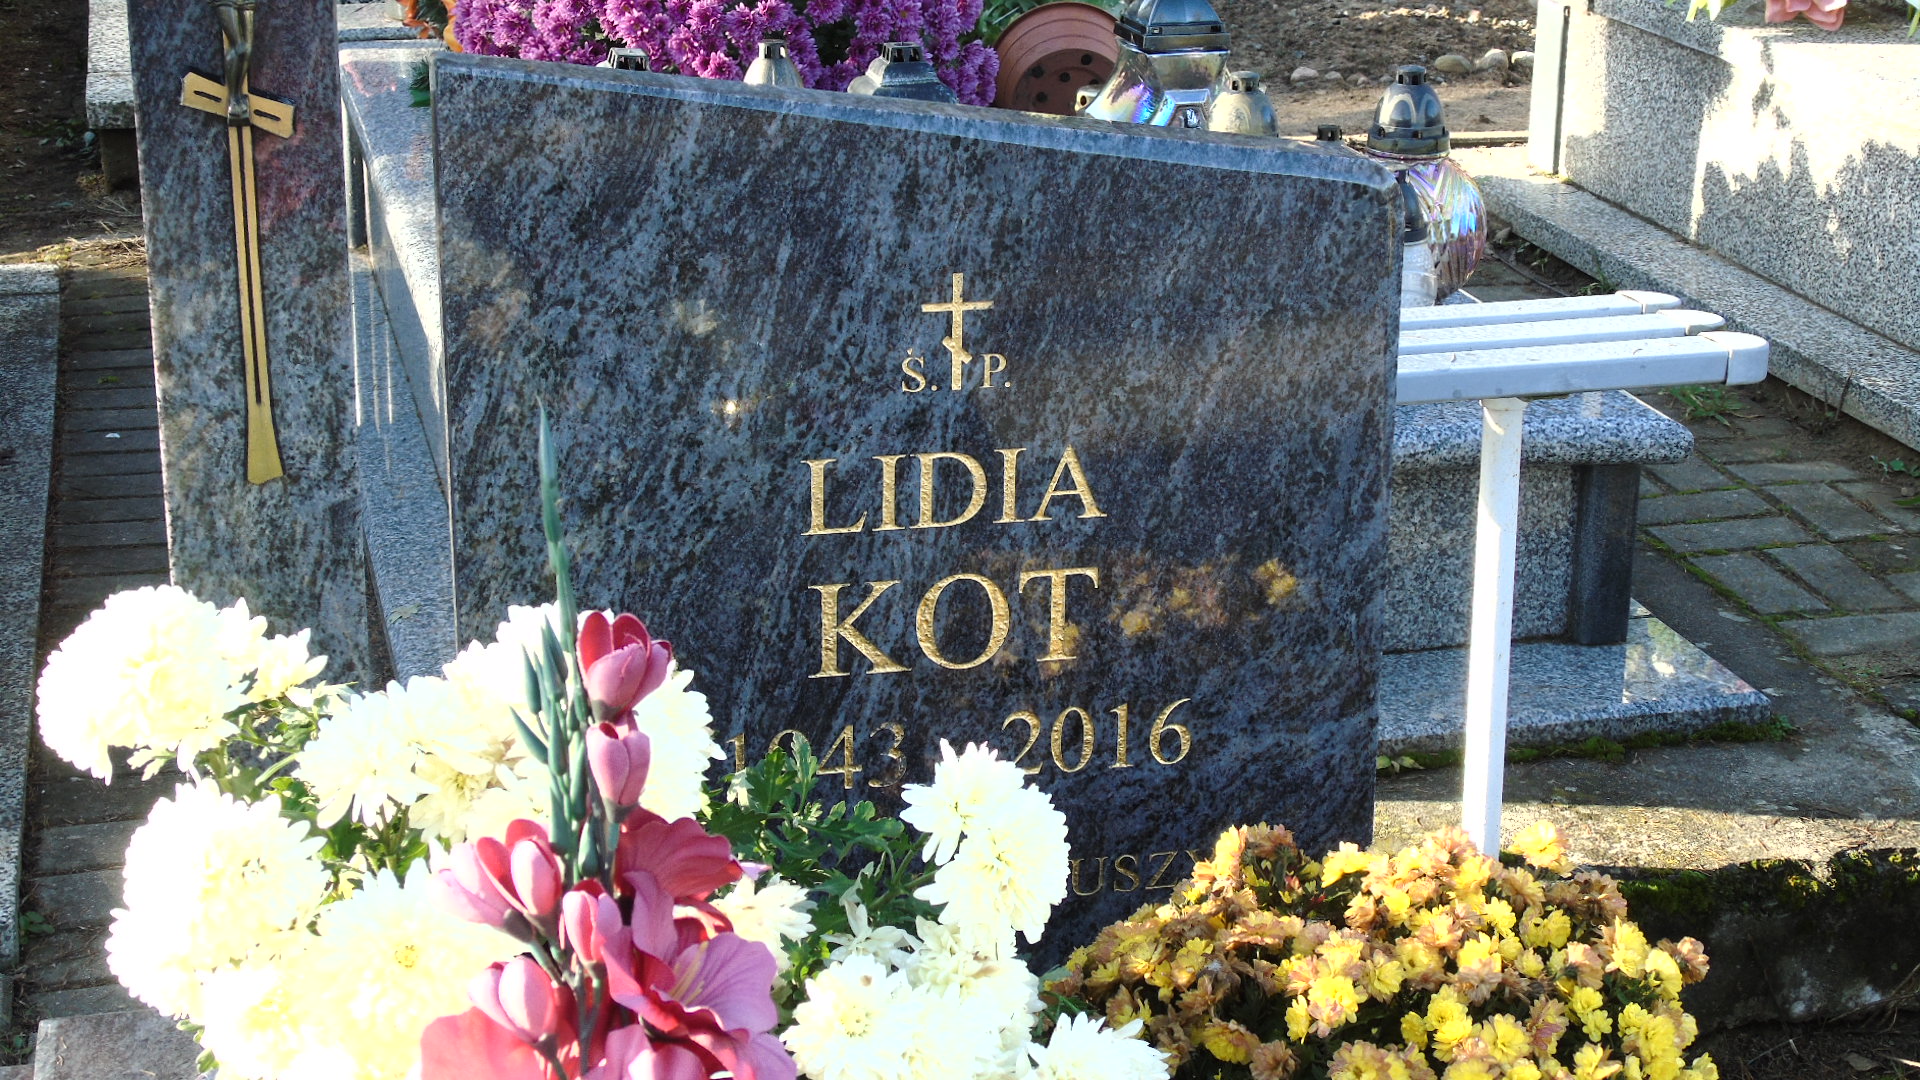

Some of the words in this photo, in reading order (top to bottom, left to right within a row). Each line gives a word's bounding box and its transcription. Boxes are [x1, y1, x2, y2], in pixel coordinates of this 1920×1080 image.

[979, 353, 1011, 388] P.
[800, 444, 1107, 536] LIDIA
[807, 566, 1099, 679] KOT
[1001, 698, 1192, 775] 2016
